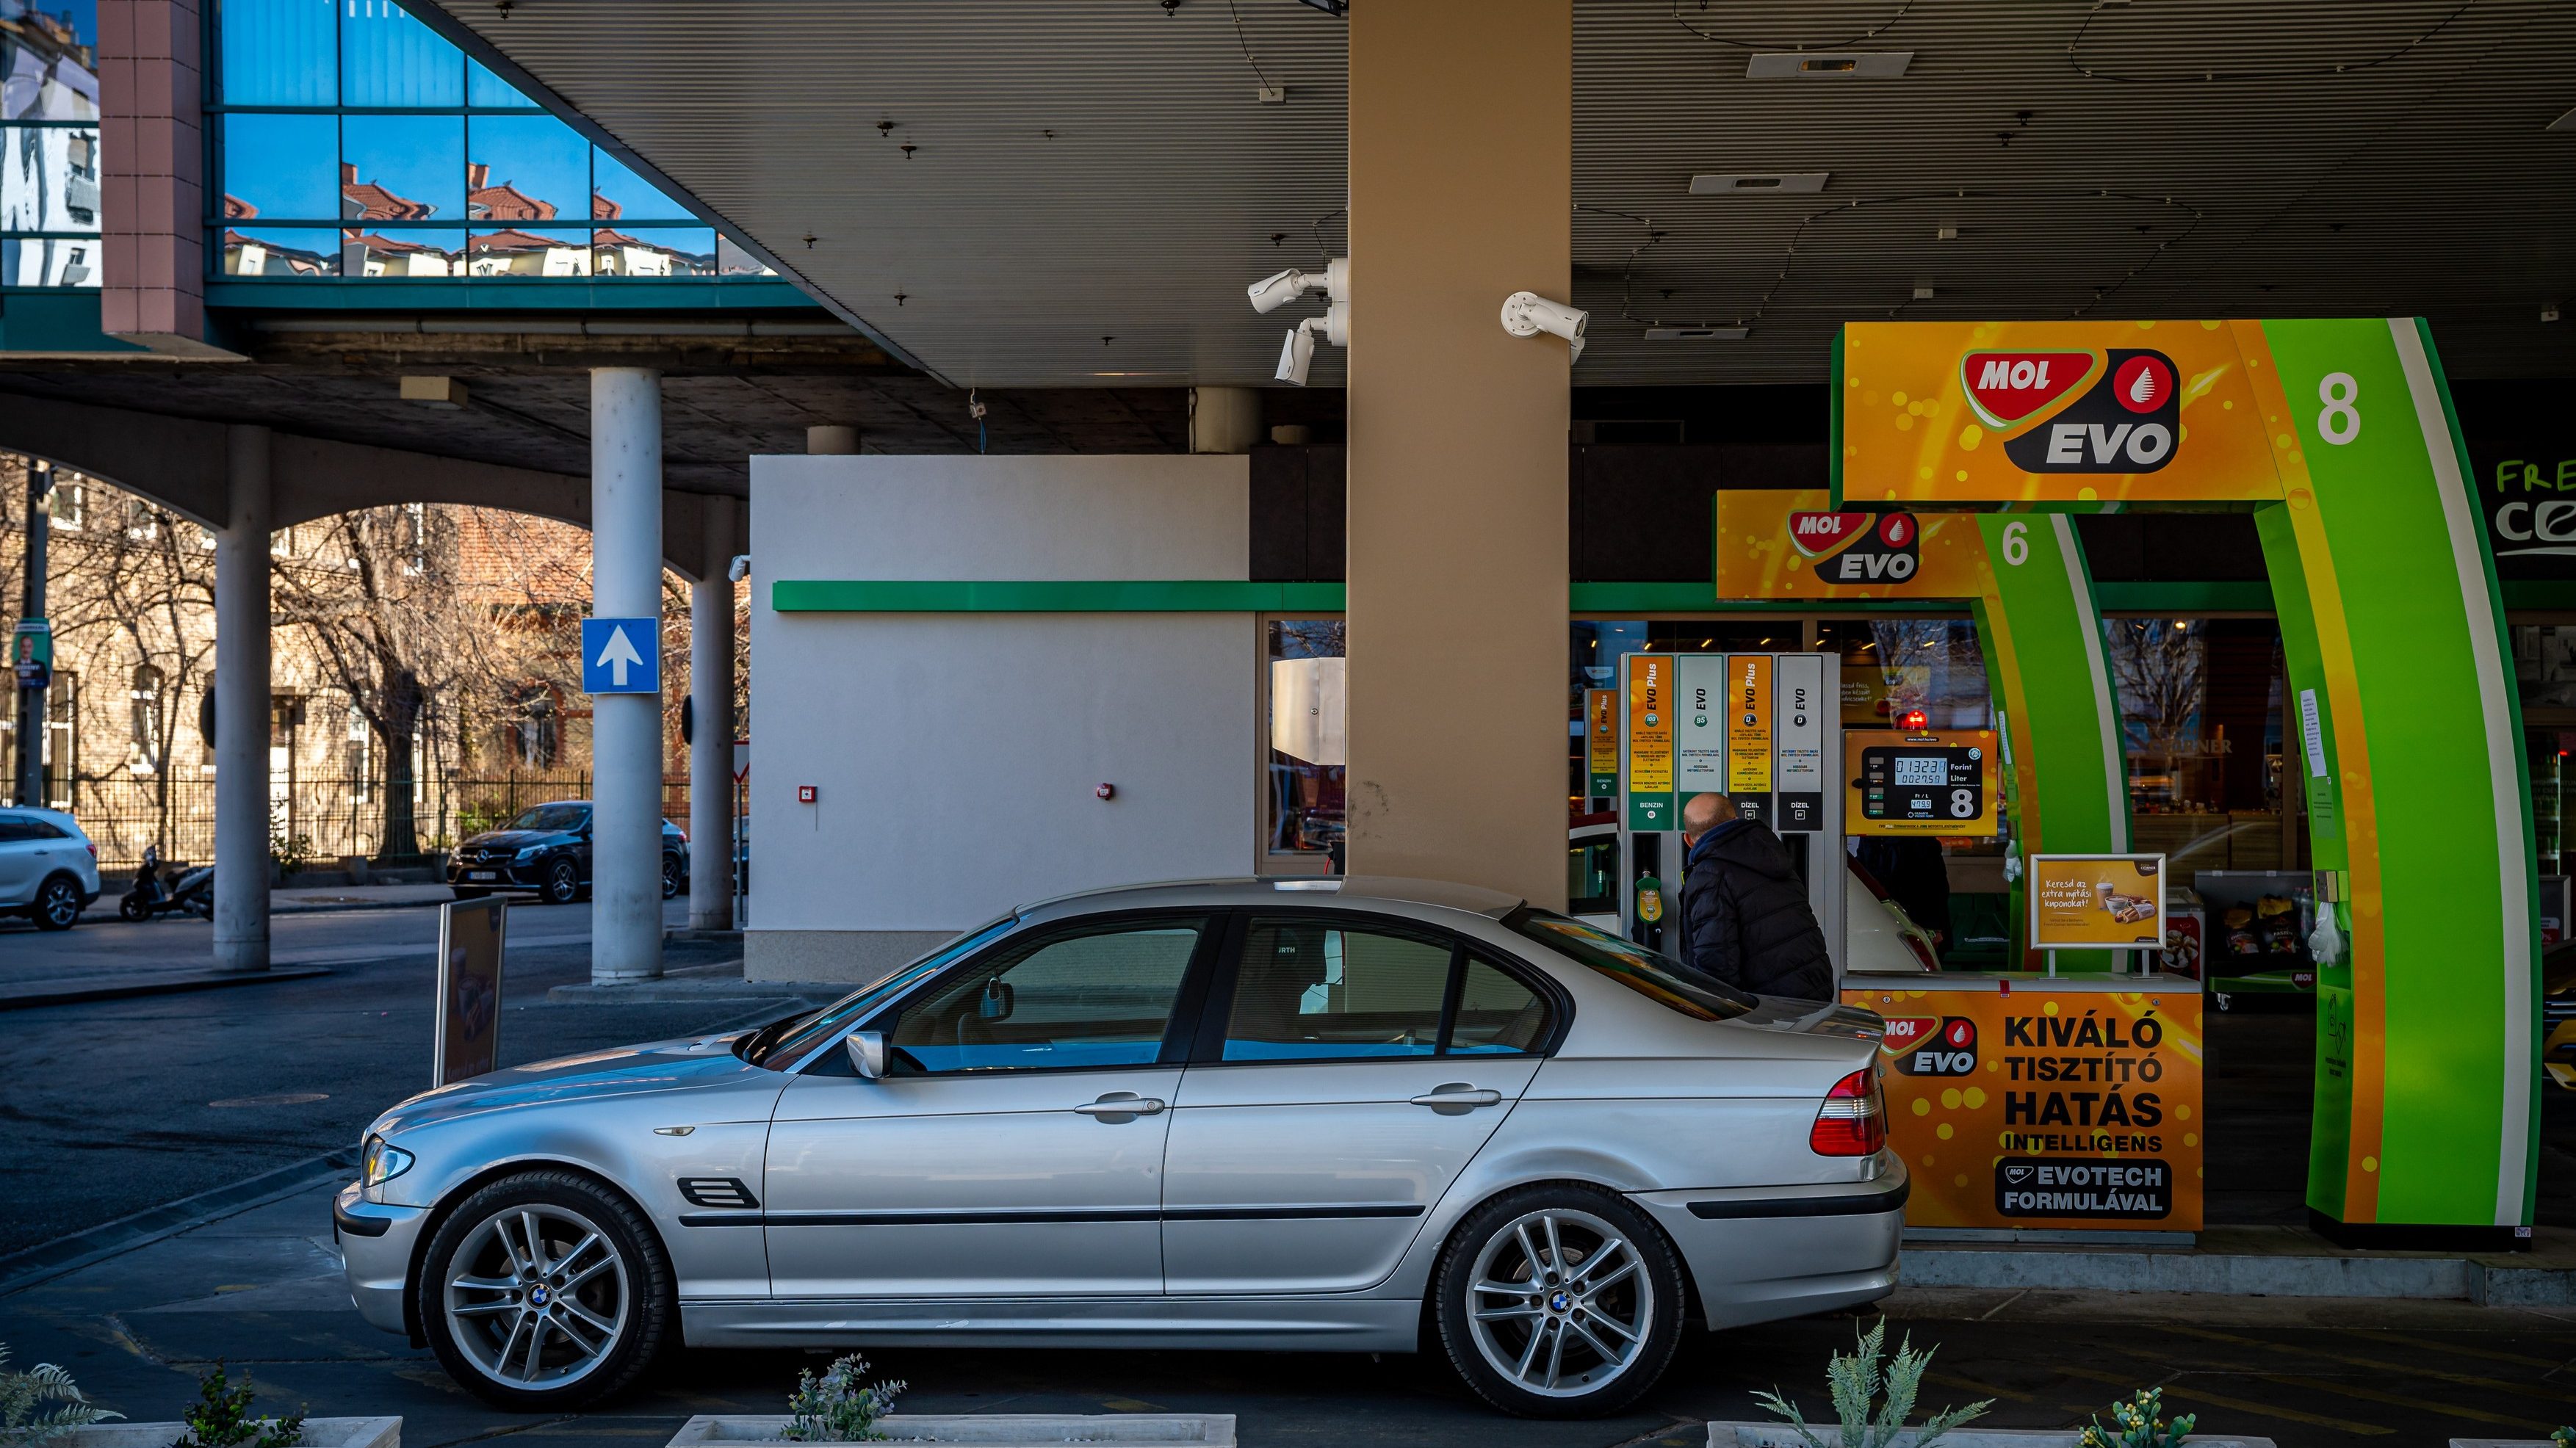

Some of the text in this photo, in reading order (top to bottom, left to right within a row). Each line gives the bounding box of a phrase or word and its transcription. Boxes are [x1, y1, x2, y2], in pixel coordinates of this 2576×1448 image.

[1977, 360, 2052, 391] MOL
[2317, 372, 2361, 446] 8
[2046, 422, 2172, 465] EVO
[1797, 515, 1841, 535] MOL
[2002, 521, 2030, 566] 6
[1839, 553, 1914, 579] EVO
[1646, 663, 1656, 710] EVO Plus
[1696, 688, 1706, 710] EVO
[1745, 663, 1755, 710] EVO Plus
[1796, 688, 1805, 710] EVO
[1950, 789, 1974, 818] 8
[2042, 889, 2063, 898] extra
[2066, 888, 2092, 899] nyitási
[2046, 879, 2074, 888] Keresd
[2045, 899, 2088, 910] kuponokat!
[2294, 974, 2312, 982] MOL
[2005, 1009, 2162, 1049] KIVÁLÓ
[1913, 1052, 1974, 1073] EVO
[2005, 1051, 2162, 1082] TISZTÍTÓ
[2005, 1084, 2162, 1127] HATÁS
[2005, 1133, 2162, 1152] INTELLIGENS
[2037, 1166, 2162, 1186] EVOTECH
[2005, 1188, 2162, 1212] FORMULÁVAL
